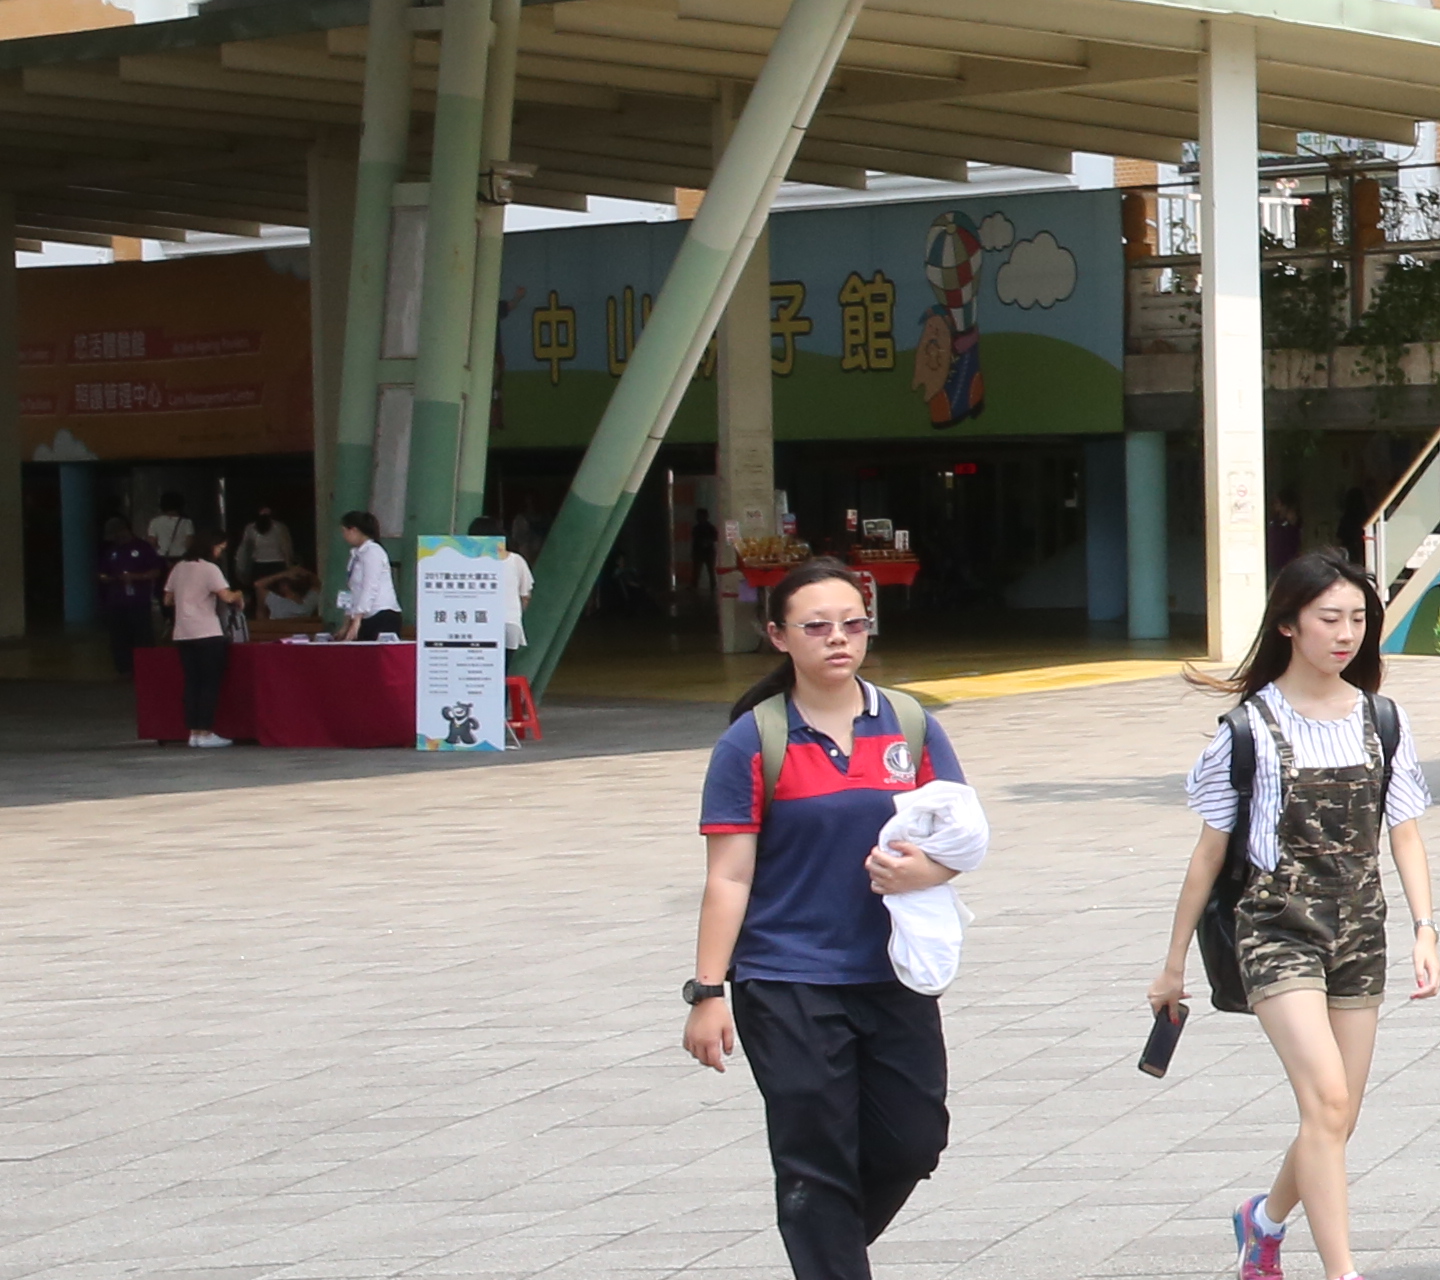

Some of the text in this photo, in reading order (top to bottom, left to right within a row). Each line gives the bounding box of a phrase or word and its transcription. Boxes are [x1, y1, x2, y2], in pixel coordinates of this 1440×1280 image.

[531, 269, 896, 387] 中山子館
[434, 610, 488, 624] 接待區
